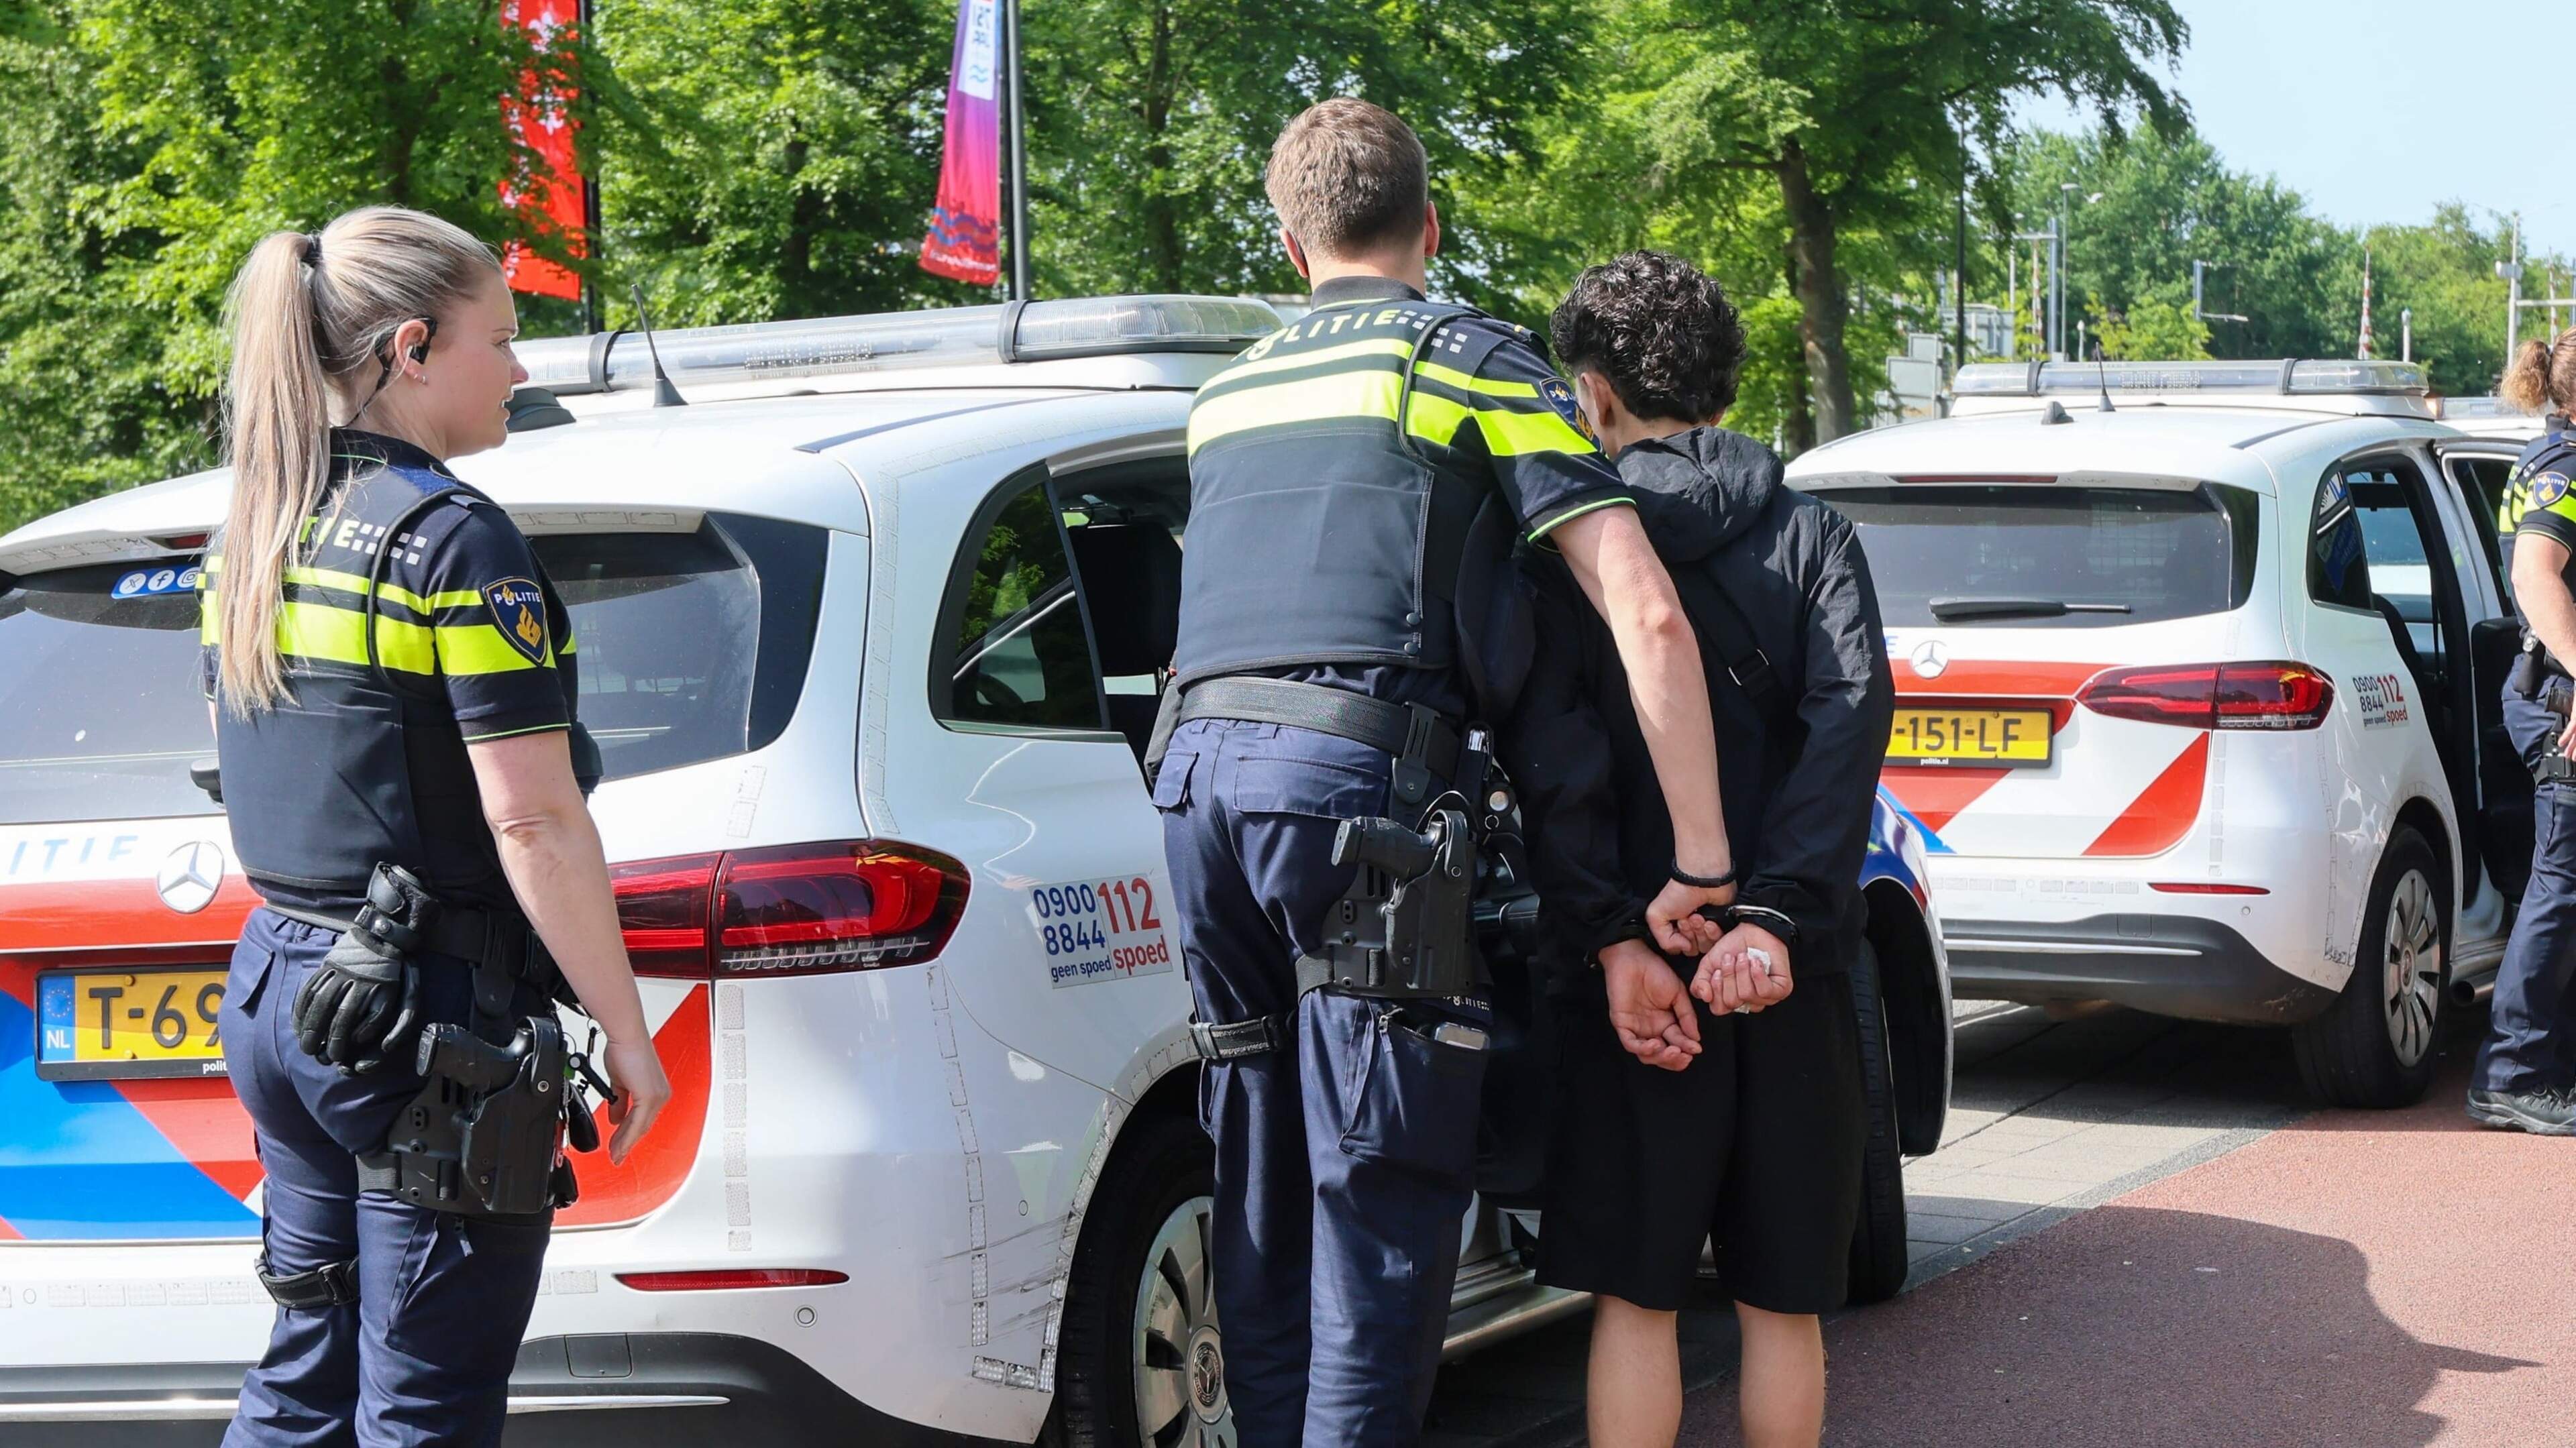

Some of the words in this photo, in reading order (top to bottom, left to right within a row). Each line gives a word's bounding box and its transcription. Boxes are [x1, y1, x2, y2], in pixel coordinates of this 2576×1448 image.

[1230, 309, 1401, 361] OLITIE
[494, 592, 541, 606] POLITIE
[2353, 676, 2379, 693] 0900
[2376, 674, 2404, 703] 112
[2359, 694, 2383, 712] 8844
[2386, 704, 2408, 726] spoed
[1895, 717, 2021, 752] -151-LF
[1921, 757, 1949, 766] politie.nl
[9, 834, 139, 875] ITIE
[1032, 883, 1097, 919] 0900
[1097, 877, 1161, 934] 112
[1042, 920, 1106, 956] 8844
[1051, 962, 1079, 983] geen
[1080, 956, 1112, 979] spoed
[1112, 934, 1170, 976] spoed
[88, 982, 227, 1050] T-69
[46, 1029, 71, 1050] NL
[203, 1060, 228, 1074] polit
